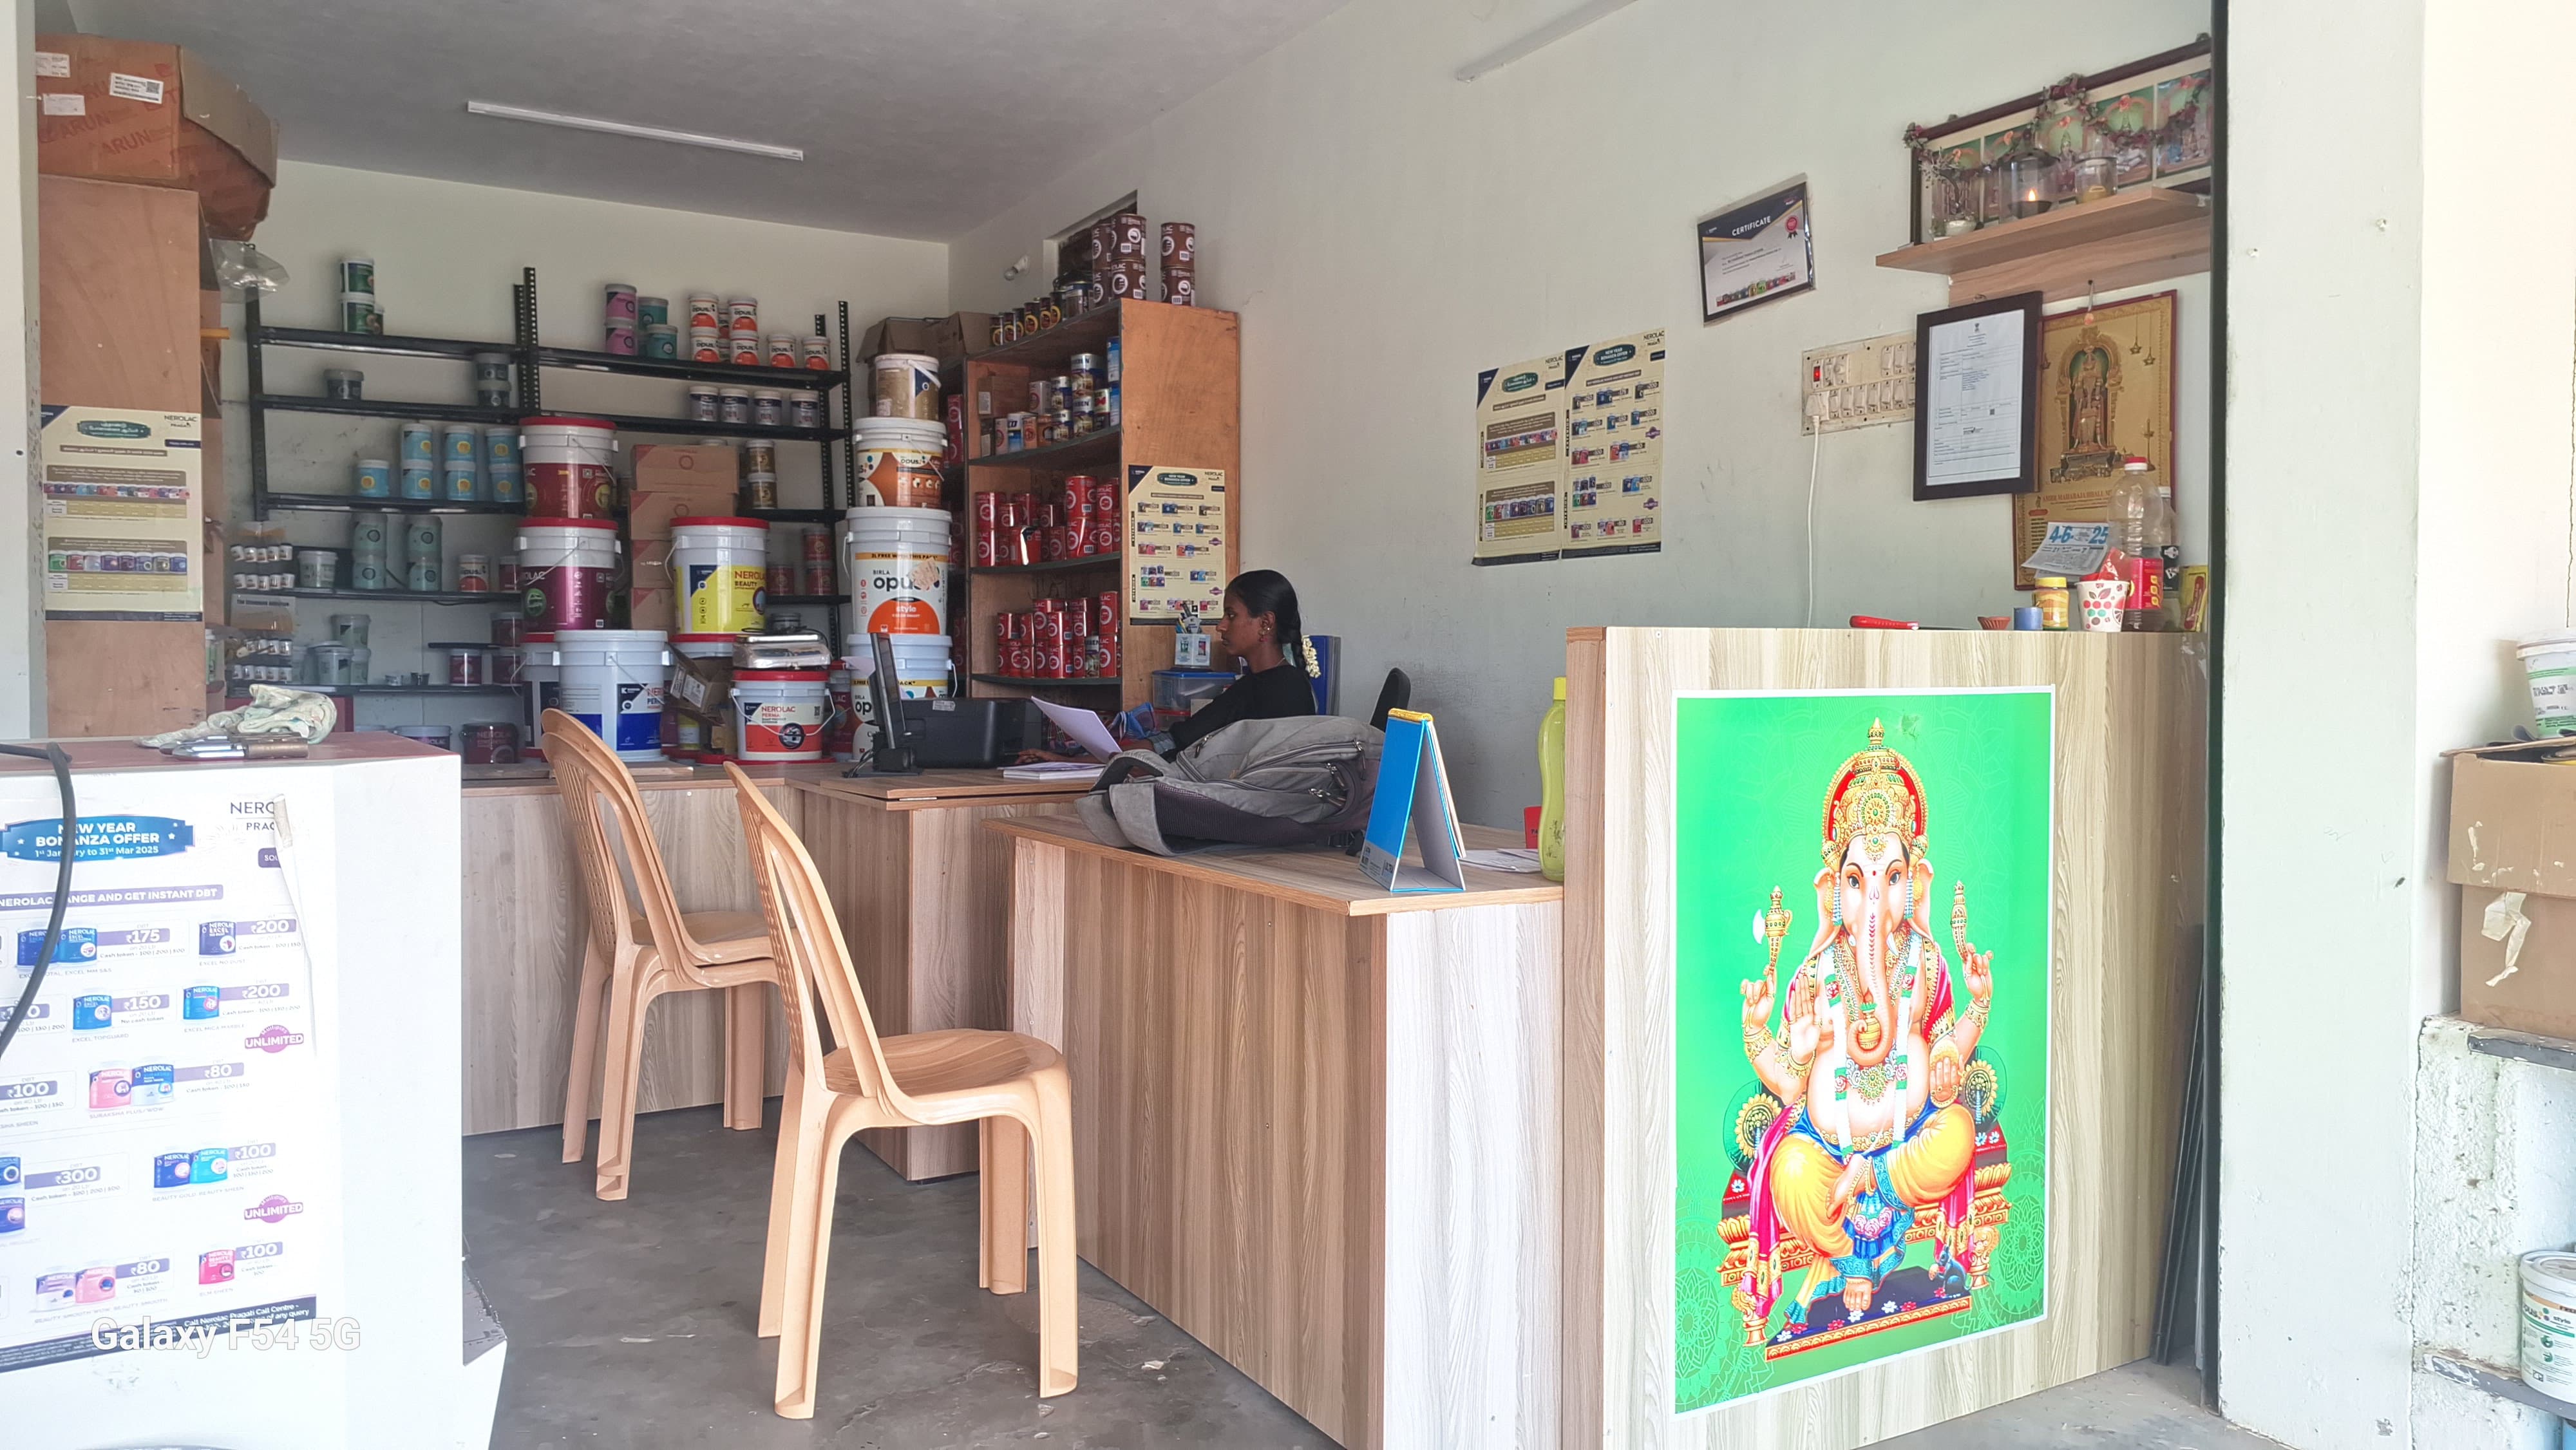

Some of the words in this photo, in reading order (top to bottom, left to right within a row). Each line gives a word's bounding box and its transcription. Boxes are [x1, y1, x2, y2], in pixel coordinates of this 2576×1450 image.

[102, 130, 152, 155] ARUN
[1732, 216, 1771, 236] CERTIFICATE
[855, 701, 872, 715] op
[231, 802, 275, 814] NERO
[98, 823, 136, 833] YEAR
[113, 833, 160, 844] OFFER
[88, 848, 97, 856] to
[116, 847, 134, 855] Mar
[136, 845, 159, 854] 2025
[0, 897, 53, 907] NEROLAC
[67, 894, 96, 903] ANGE
[100, 892, 122, 902] AND
[124, 890, 147, 901] GET
[148, 889, 194, 900] INSTANT
[195, 888, 218, 898] DBT
[245, 1034, 304, 1048] UNLIMITED
[245, 1203, 303, 1219] UNLIMITED
[256, 1307, 270, 1315] Call
[271, 1304, 296, 1313] Centre
[289, 1309, 310, 1321] query
